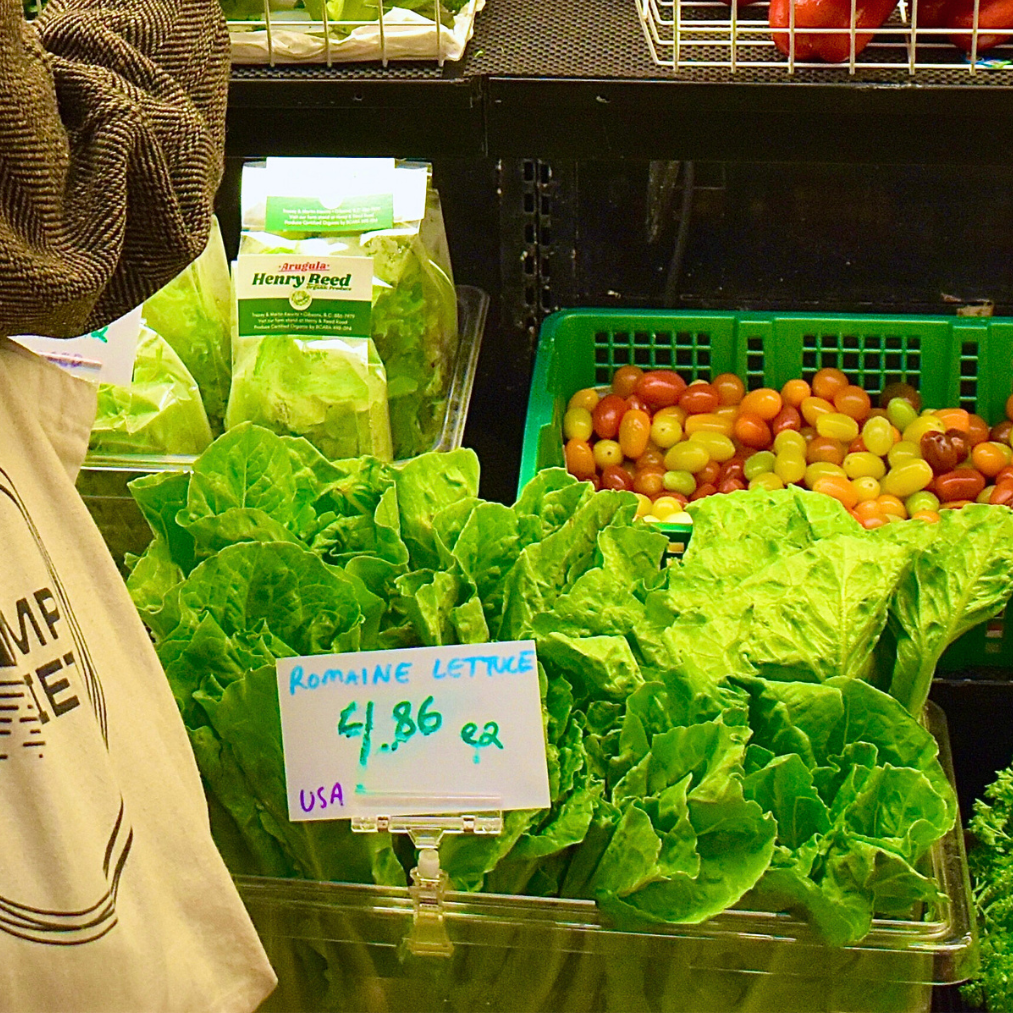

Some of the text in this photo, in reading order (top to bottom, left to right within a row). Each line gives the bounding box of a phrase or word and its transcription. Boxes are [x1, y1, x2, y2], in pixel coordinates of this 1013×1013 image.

[252, 272, 352, 288] Henry Reed
[281, 261, 326, 272] Arugula
[289, 649, 536, 695] ROMAINE LETTUCE
[338, 696, 443, 766] 4.86
[299, 782, 344, 813] USA
